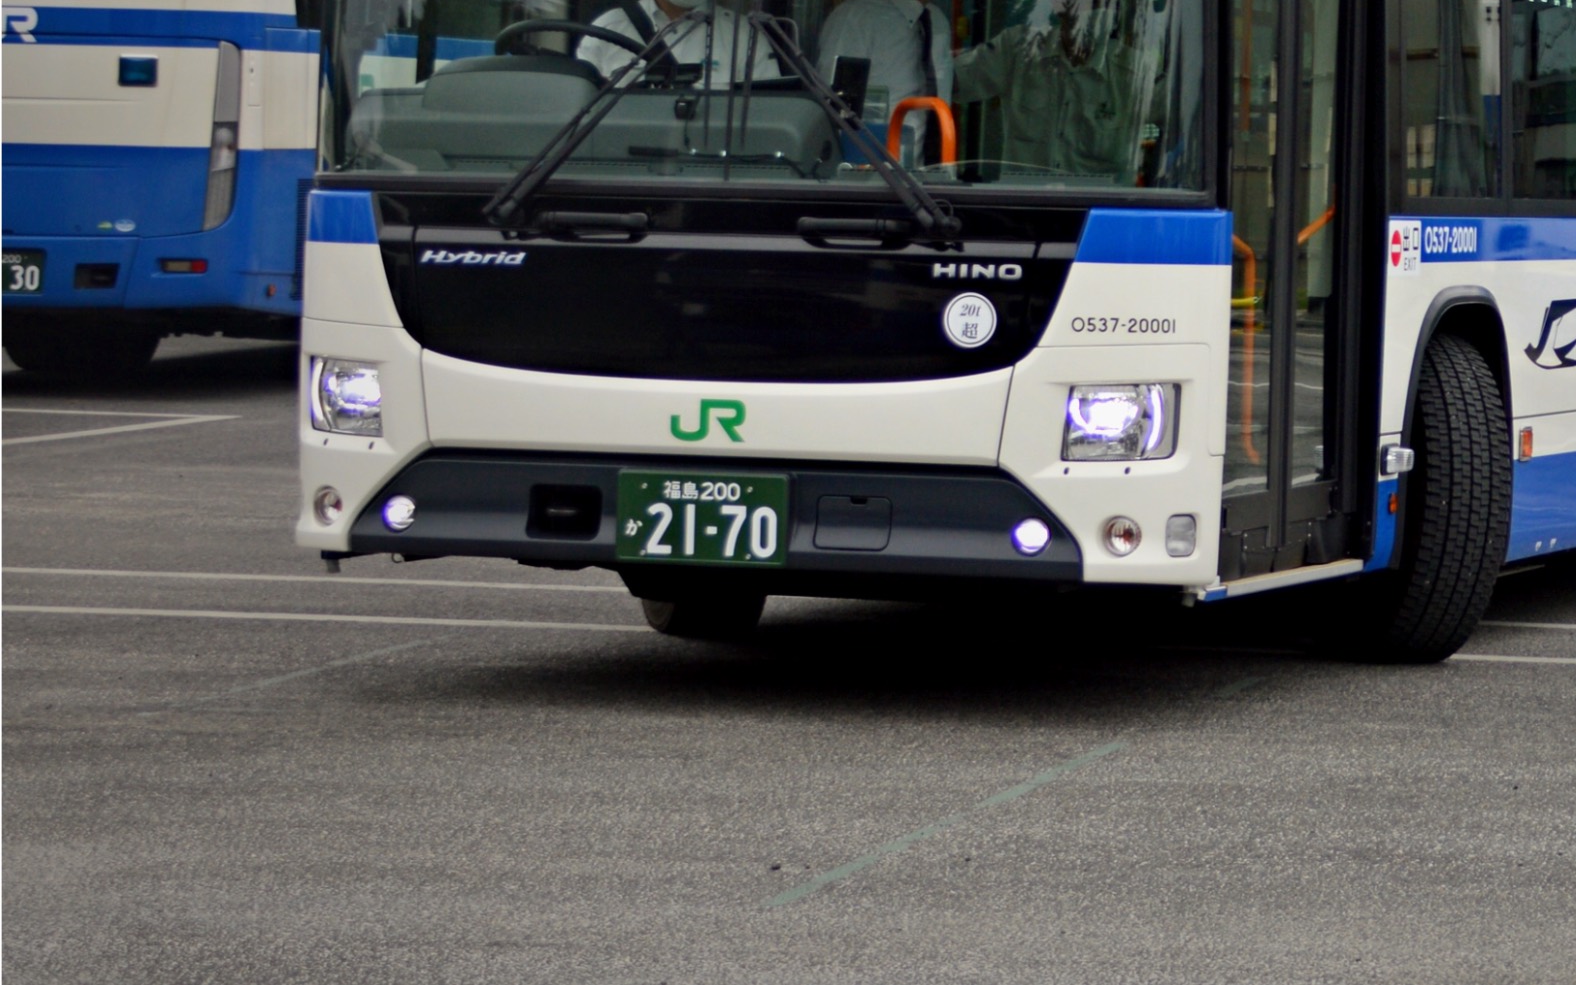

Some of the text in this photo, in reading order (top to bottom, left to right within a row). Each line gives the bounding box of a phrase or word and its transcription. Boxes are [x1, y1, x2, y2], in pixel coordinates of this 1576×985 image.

[420, 250, 527, 265] Hybrid
[933, 262, 1023, 280] HINO
[670, 398, 746, 443] JR
[646, 502, 778, 559] 21-70
